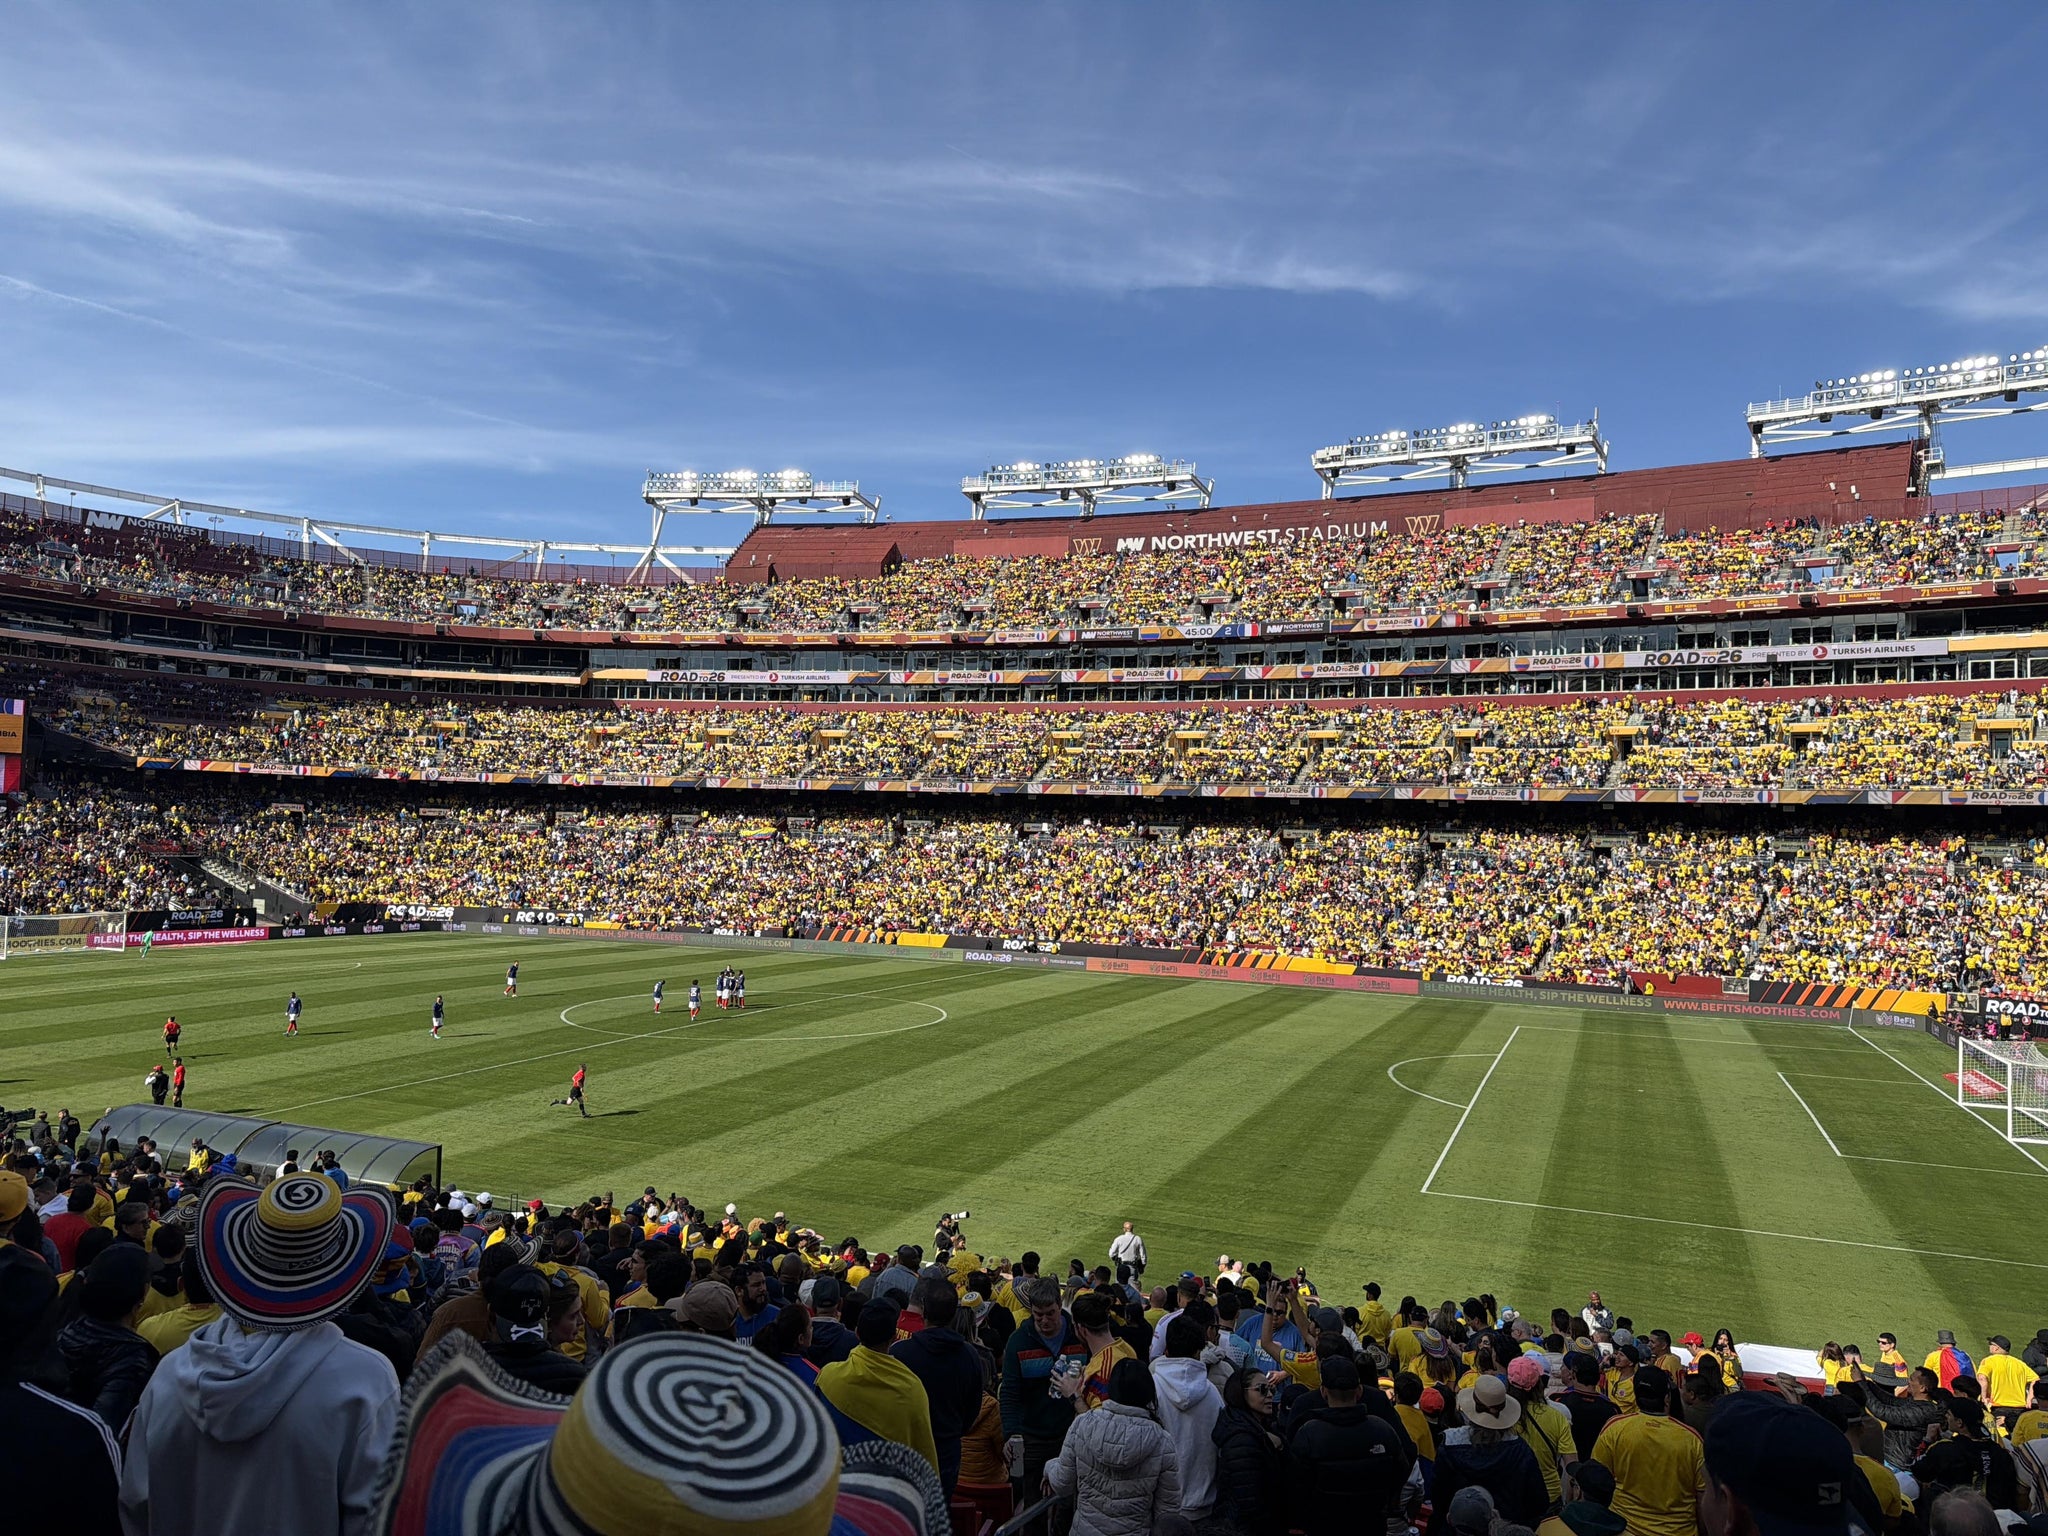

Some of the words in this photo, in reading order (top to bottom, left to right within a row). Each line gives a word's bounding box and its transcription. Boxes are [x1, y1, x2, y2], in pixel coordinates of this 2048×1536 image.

[127, 516, 205, 537] NORTHWEST
[1152, 529, 1280, 551] NORTHWEST
[1285, 521, 1387, 542] STADIUM
[1839, 594, 1846, 602] 11
[1570, 610, 1574, 618] 7
[1184, 628, 1213, 636] 45:00
[1225, 627, 1232, 635] 2
[1284, 623, 1324, 631] NORTHWEST
[1644, 652, 1700, 666] ROAD
[1702, 656, 1716, 664] TO
[1717, 650, 1743, 663] 26
[1832, 646, 1872, 655] TURKISH
[1874, 644, 1916, 654] AIRLINES
[1532, 658, 1561, 666] ROAD
[1568, 656, 1582, 664] 26
[660, 672, 698, 682] ROAD
[709, 672, 725, 682] 26
[1702, 790, 1732, 798] ROAD
[1740, 790, 1754, 798] 26
[1971, 791, 2006, 800] ROAD
[2017, 792, 2034, 800] 26
[171, 911, 200, 920] ROAD
[210, 910, 223, 919] 26
[387, 905, 426, 919] ROAD
[438, 906, 454, 918] 26
[188, 932, 202, 940] SIP
[202, 930, 216, 938] THE
[217, 929, 264, 938] WELLNESS
[548, 928, 570, 936] BLEND
[630, 932, 644, 940] THE
[645, 933, 683, 941] WELLNESS
[965, 952, 992, 961] ROAD
[999, 953, 1012, 962] 26
[1446, 975, 1490, 985] ROAD
[1424, 983, 1462, 994] BLEND
[1464, 986, 1487, 995] THE
[1489, 988, 1537, 1000] HEALTH,
[1539, 992, 1558, 1000] SIP
[1560, 993, 1584, 1002] THE
[1586, 994, 1652, 1007] WELLNESS
[1664, 1000, 1840, 1019] WWW.BEFITSMOOTHIES.COM
[1986, 1000, 2039, 1016] ROAD
[1894, 1016, 1915, 1024] BeFit
